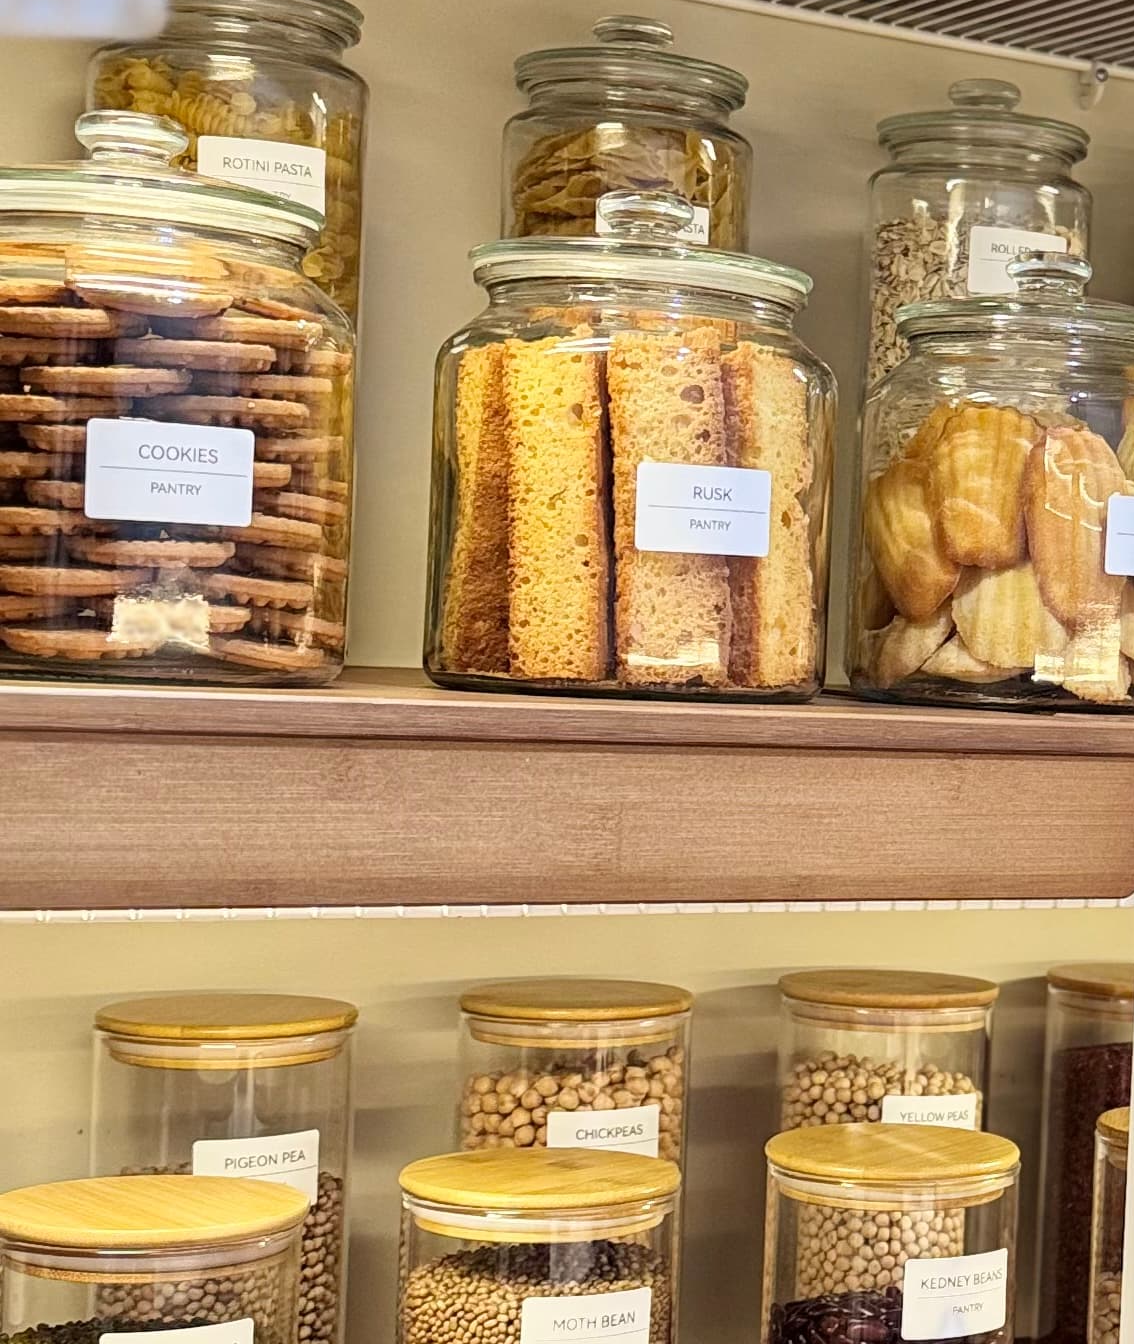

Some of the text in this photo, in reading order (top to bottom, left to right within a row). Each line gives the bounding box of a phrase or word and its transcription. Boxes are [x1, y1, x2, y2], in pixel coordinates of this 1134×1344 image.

[222, 157, 312, 178] ROTINI PASTA
[138, 444, 219, 464] COOKIES
[150, 481, 202, 496] PANTRY
[693, 485, 733, 502] RUSK
[689, 518, 732, 531] PANTRY
[900, 1110, 969, 1122] YELLOW PEAS
[575, 1124, 644, 1141] CHICKPEAS
[224, 1150, 306, 1170] PIGEON PEA
[973, 1268, 1003, 1286] BEANS
[952, 1303, 984, 1315] PANTRY
[553, 1311, 636, 1332] MOTH BEAN
